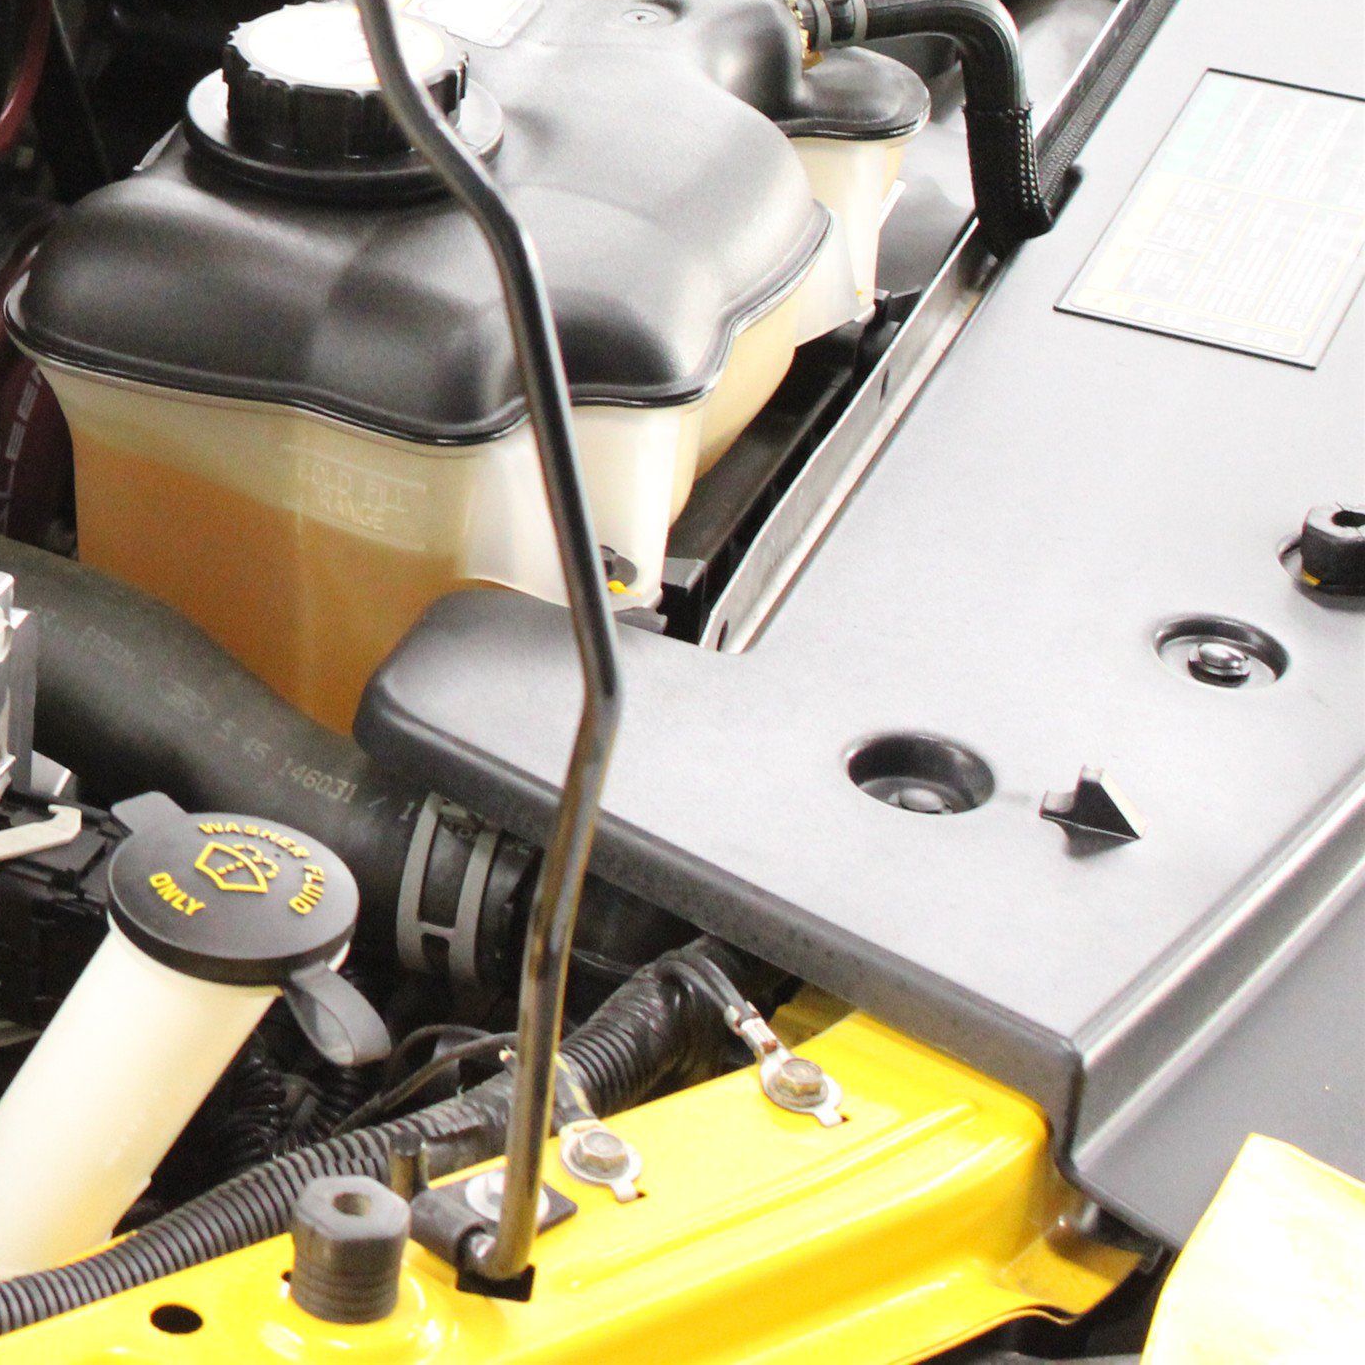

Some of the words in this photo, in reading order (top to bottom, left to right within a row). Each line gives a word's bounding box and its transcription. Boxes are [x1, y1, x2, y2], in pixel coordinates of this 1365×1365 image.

[278, 757, 359, 804] 146031
[199, 822, 311, 859] WASHER
[288, 864, 326, 916] FLUID
[149, 872, 206, 917] ONLY
